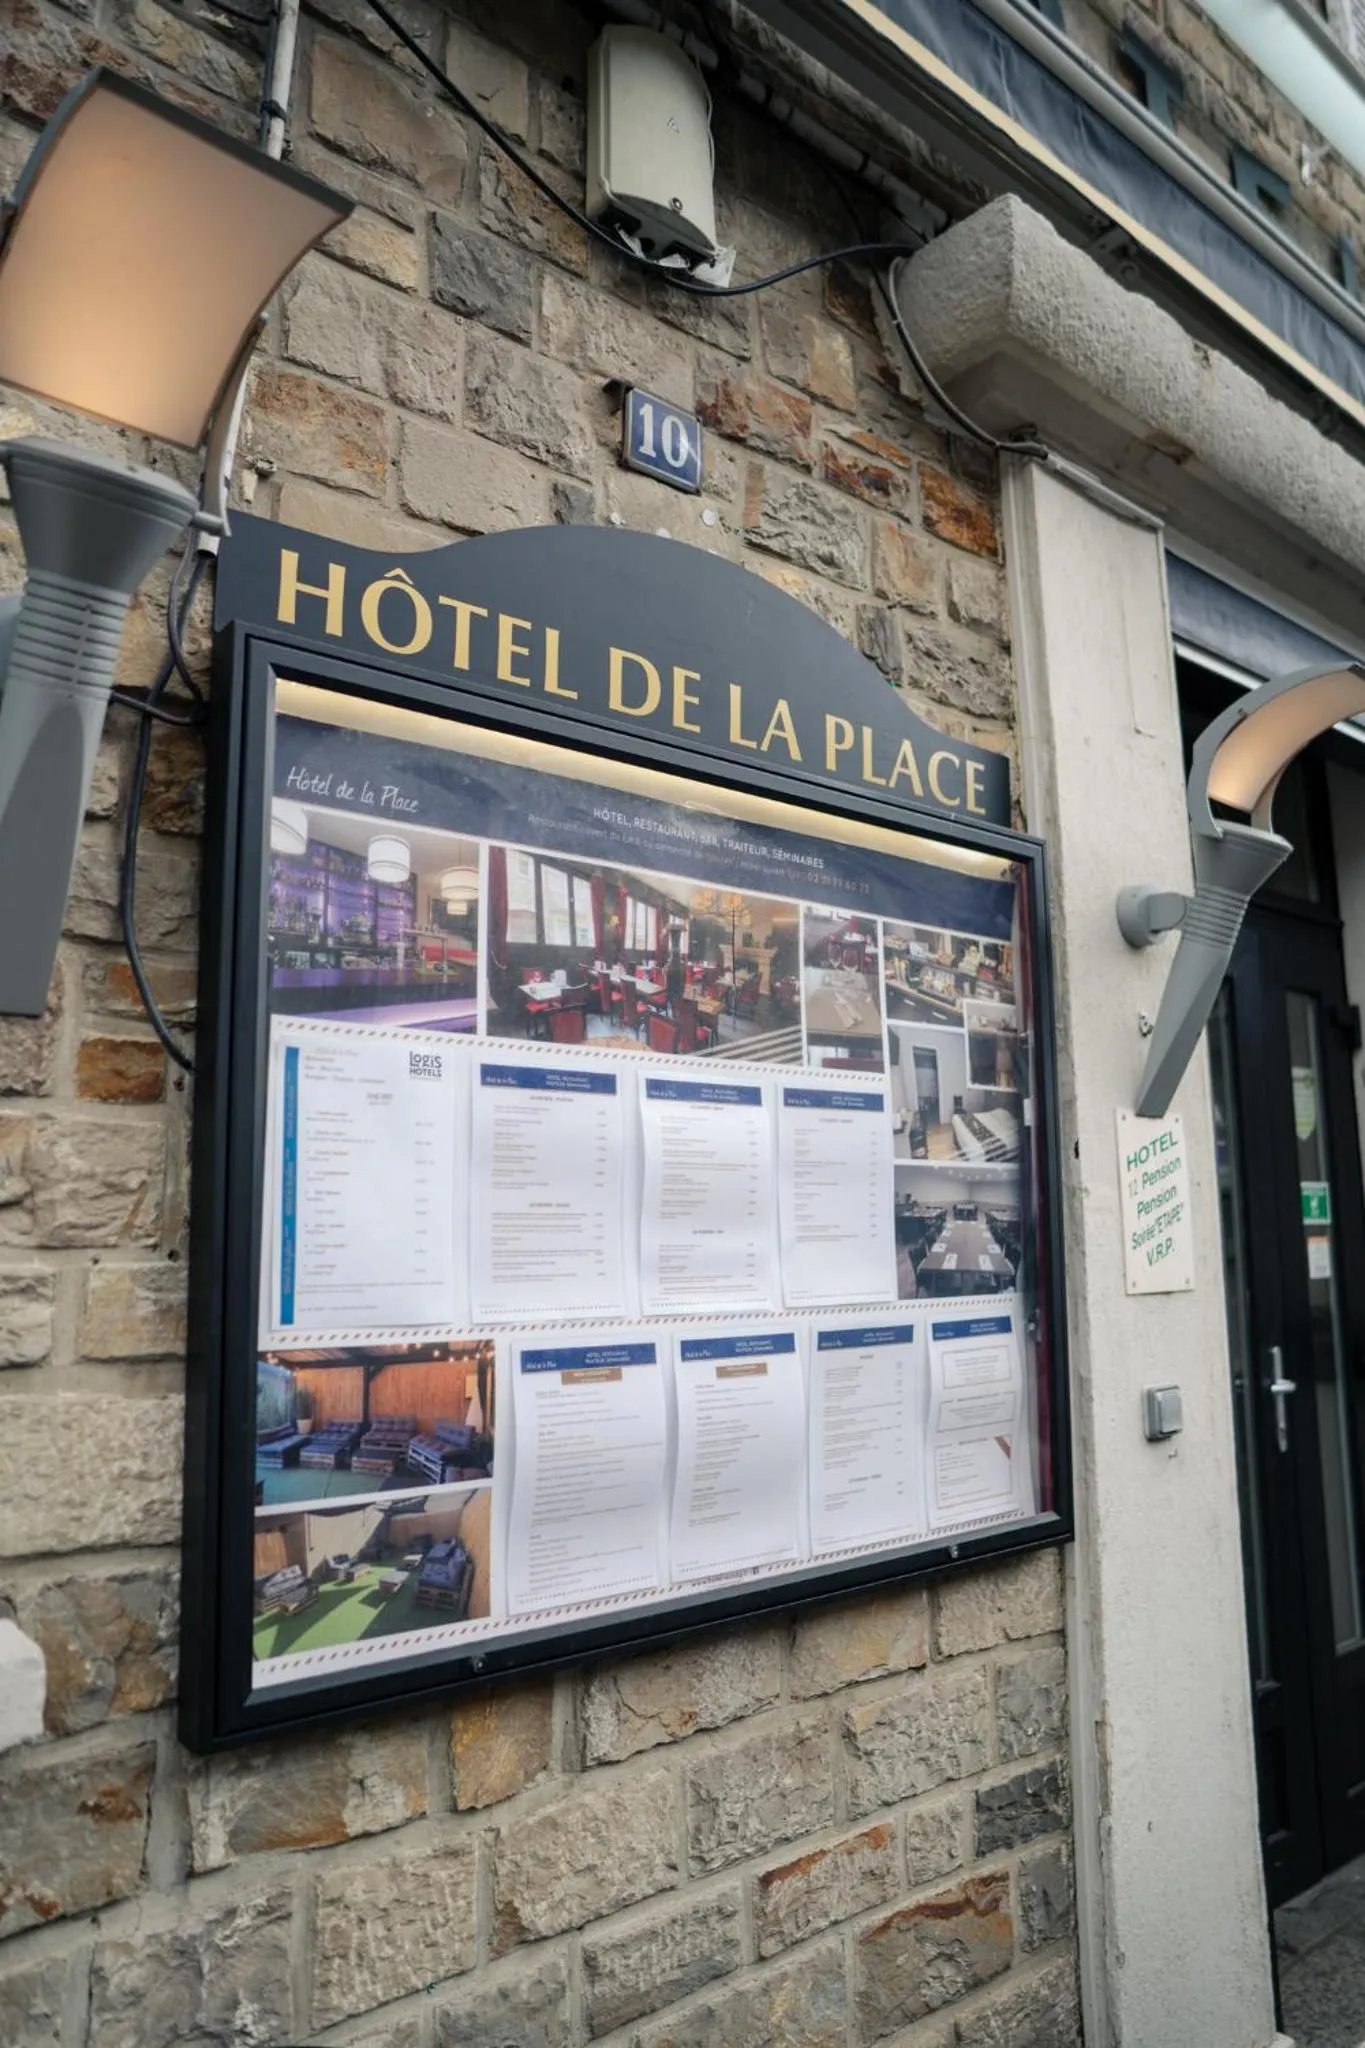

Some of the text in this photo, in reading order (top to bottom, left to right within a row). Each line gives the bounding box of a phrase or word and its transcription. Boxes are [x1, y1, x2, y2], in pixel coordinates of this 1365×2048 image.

[638, 403, 689, 467] 10
[277, 548, 987, 816] HÔTEL DE LA PLACE
[336, 780, 354, 800] de
[360, 781, 375, 804] la
[380, 785, 420, 814] Place
[1126, 1130, 1178, 1173] HOTEL
[1142, 1156, 1182, 1190] Pension
[1136, 1185, 1178, 1220] Pension
